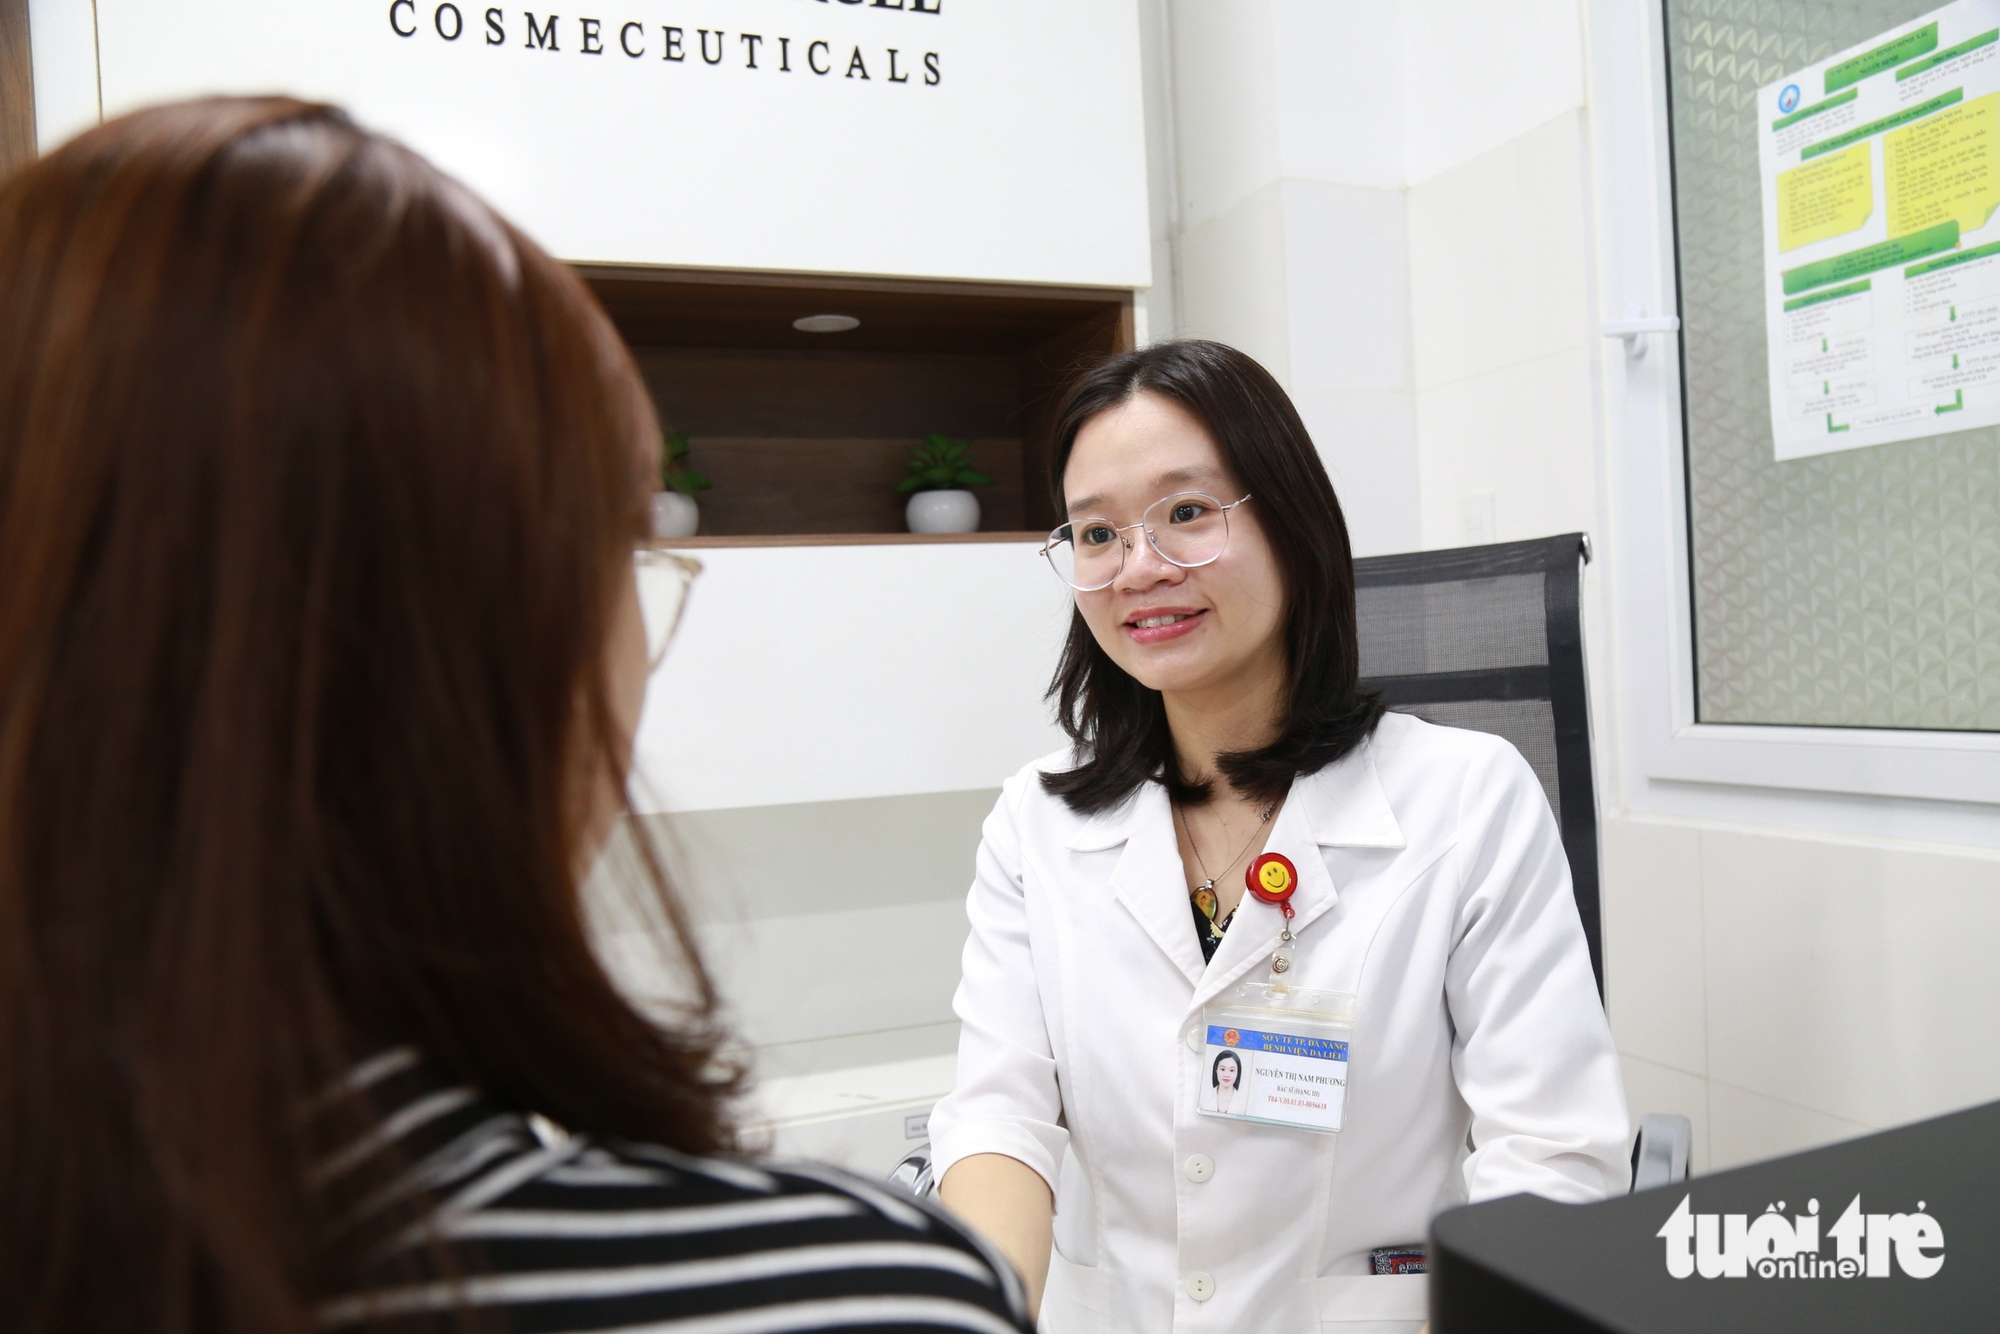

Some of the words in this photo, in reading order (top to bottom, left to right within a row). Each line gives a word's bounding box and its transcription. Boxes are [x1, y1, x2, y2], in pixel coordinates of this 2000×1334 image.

[389, 0, 942, 87] COSMECEUTICALS
[1295, 1037, 1306, 1046] TP.
[1263, 1043, 1286, 1053] BỆNH
[1288, 1046, 1308, 1056] VIỆN
[1285, 1071, 1297, 1082] THỊ
[1298, 1073, 1314, 1083] NAM
[1315, 1075, 1346, 1087] PHƯƠNG
